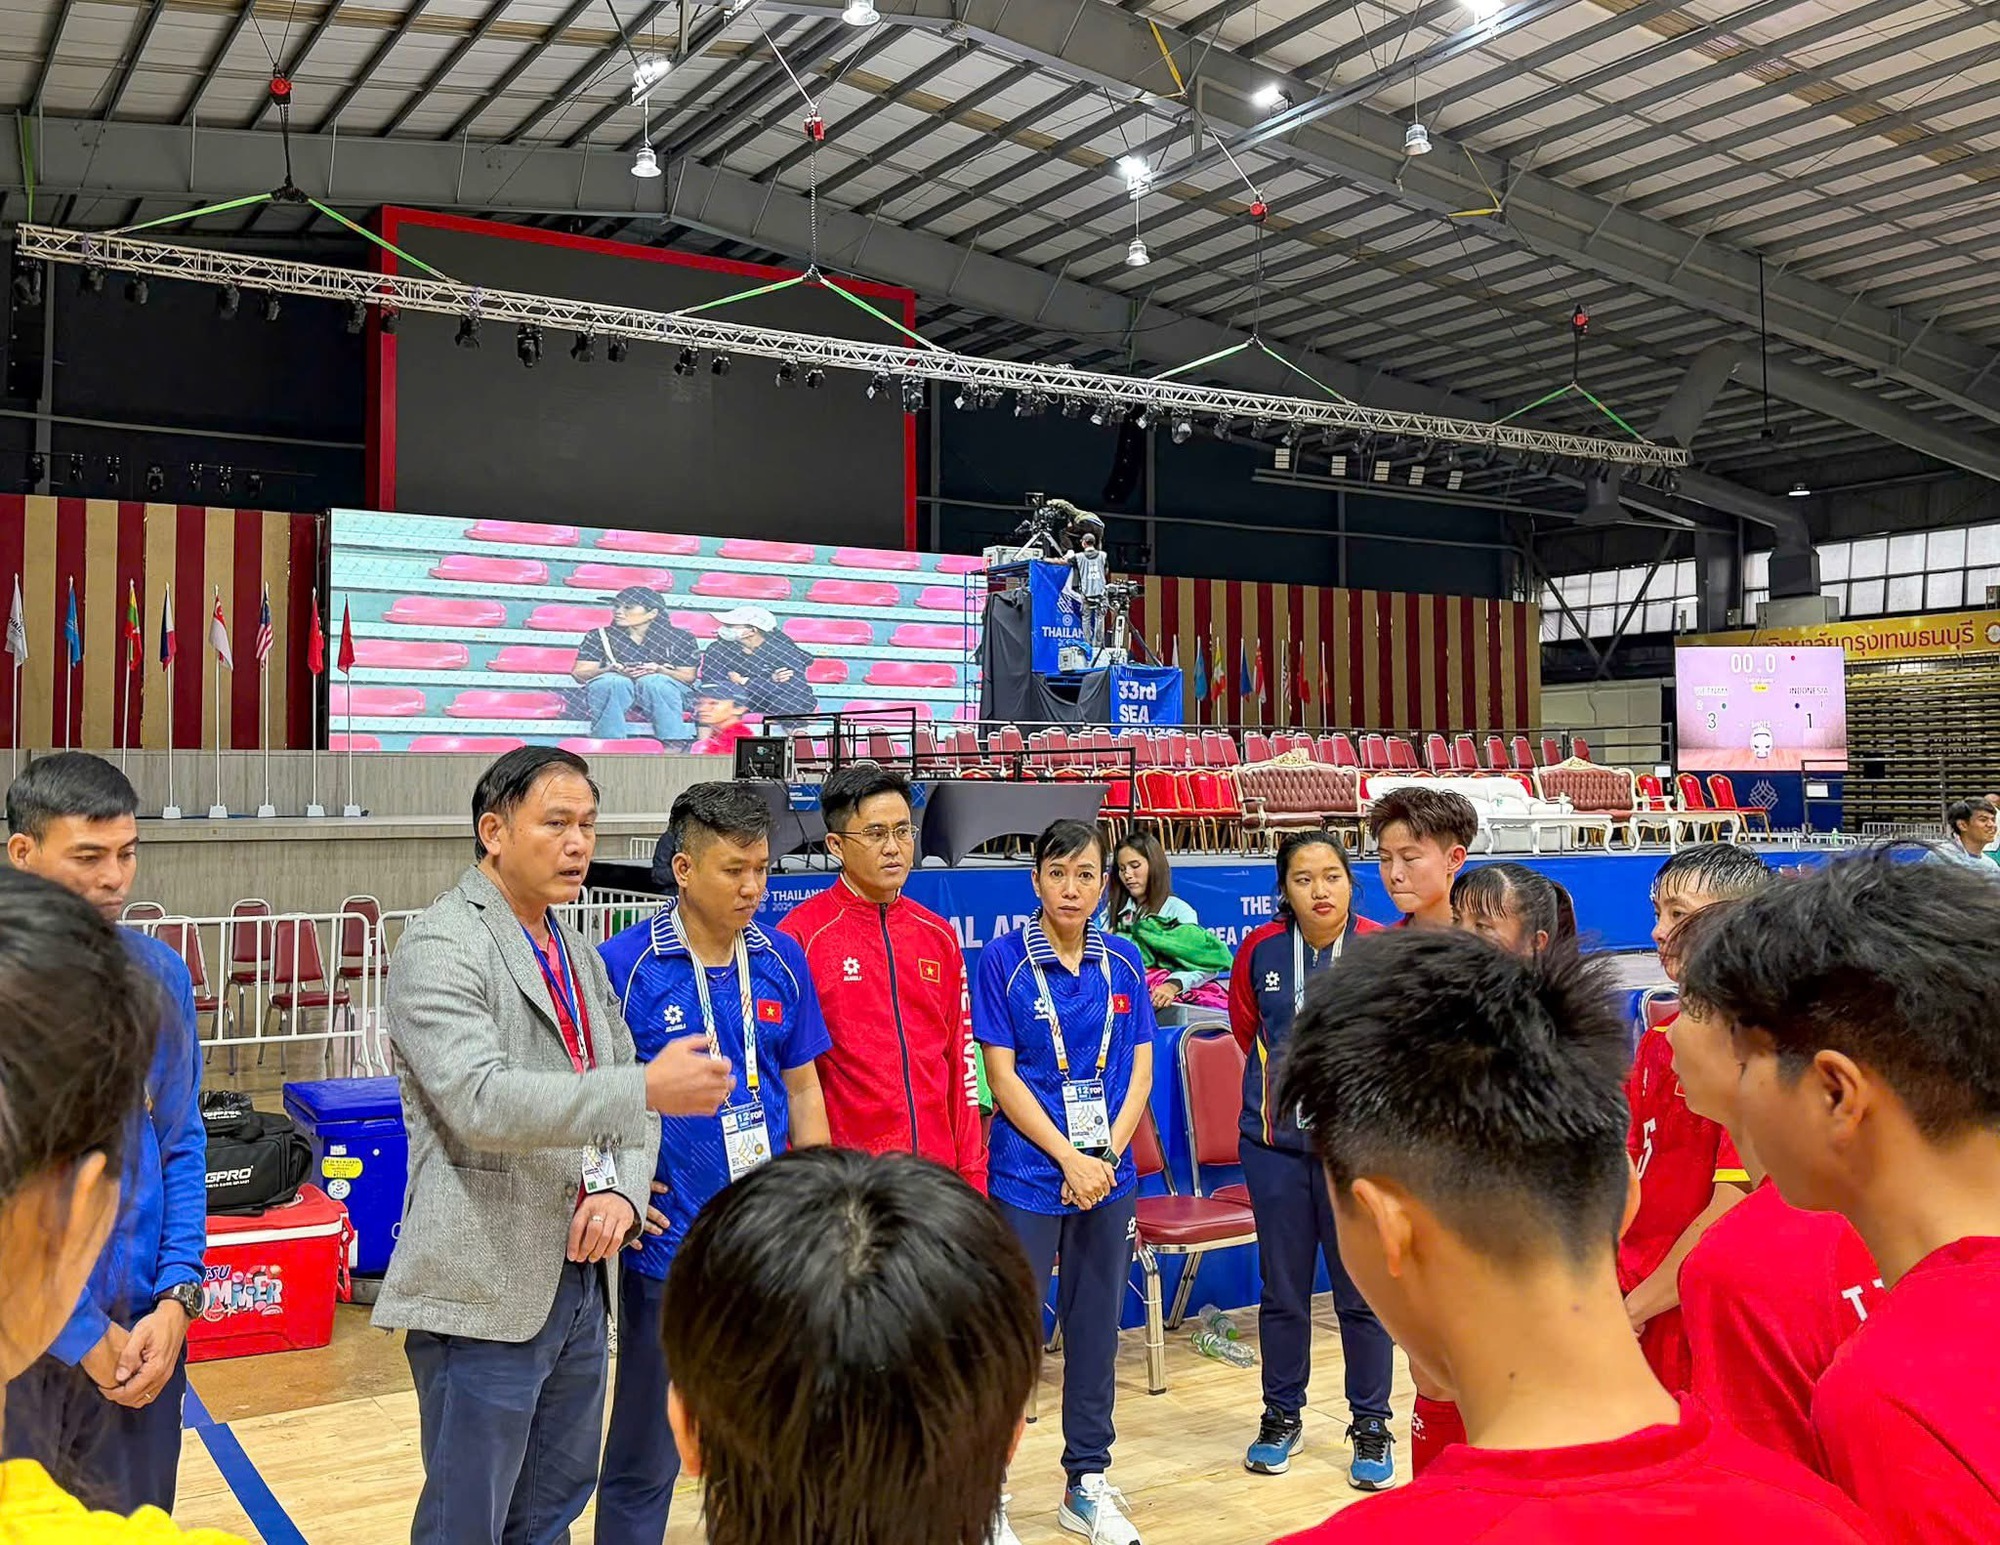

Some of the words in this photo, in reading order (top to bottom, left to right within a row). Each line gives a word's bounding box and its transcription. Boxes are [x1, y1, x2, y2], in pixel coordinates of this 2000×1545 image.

[1118, 680, 1157, 701] 33rd
[1788, 686, 1829, 696] INDONESIA
[1119, 703, 1150, 724] SEA
[1706, 712, 1718, 730] 3
[1805, 712, 1813, 730] 1
[1240, 896, 1272, 916] THE
